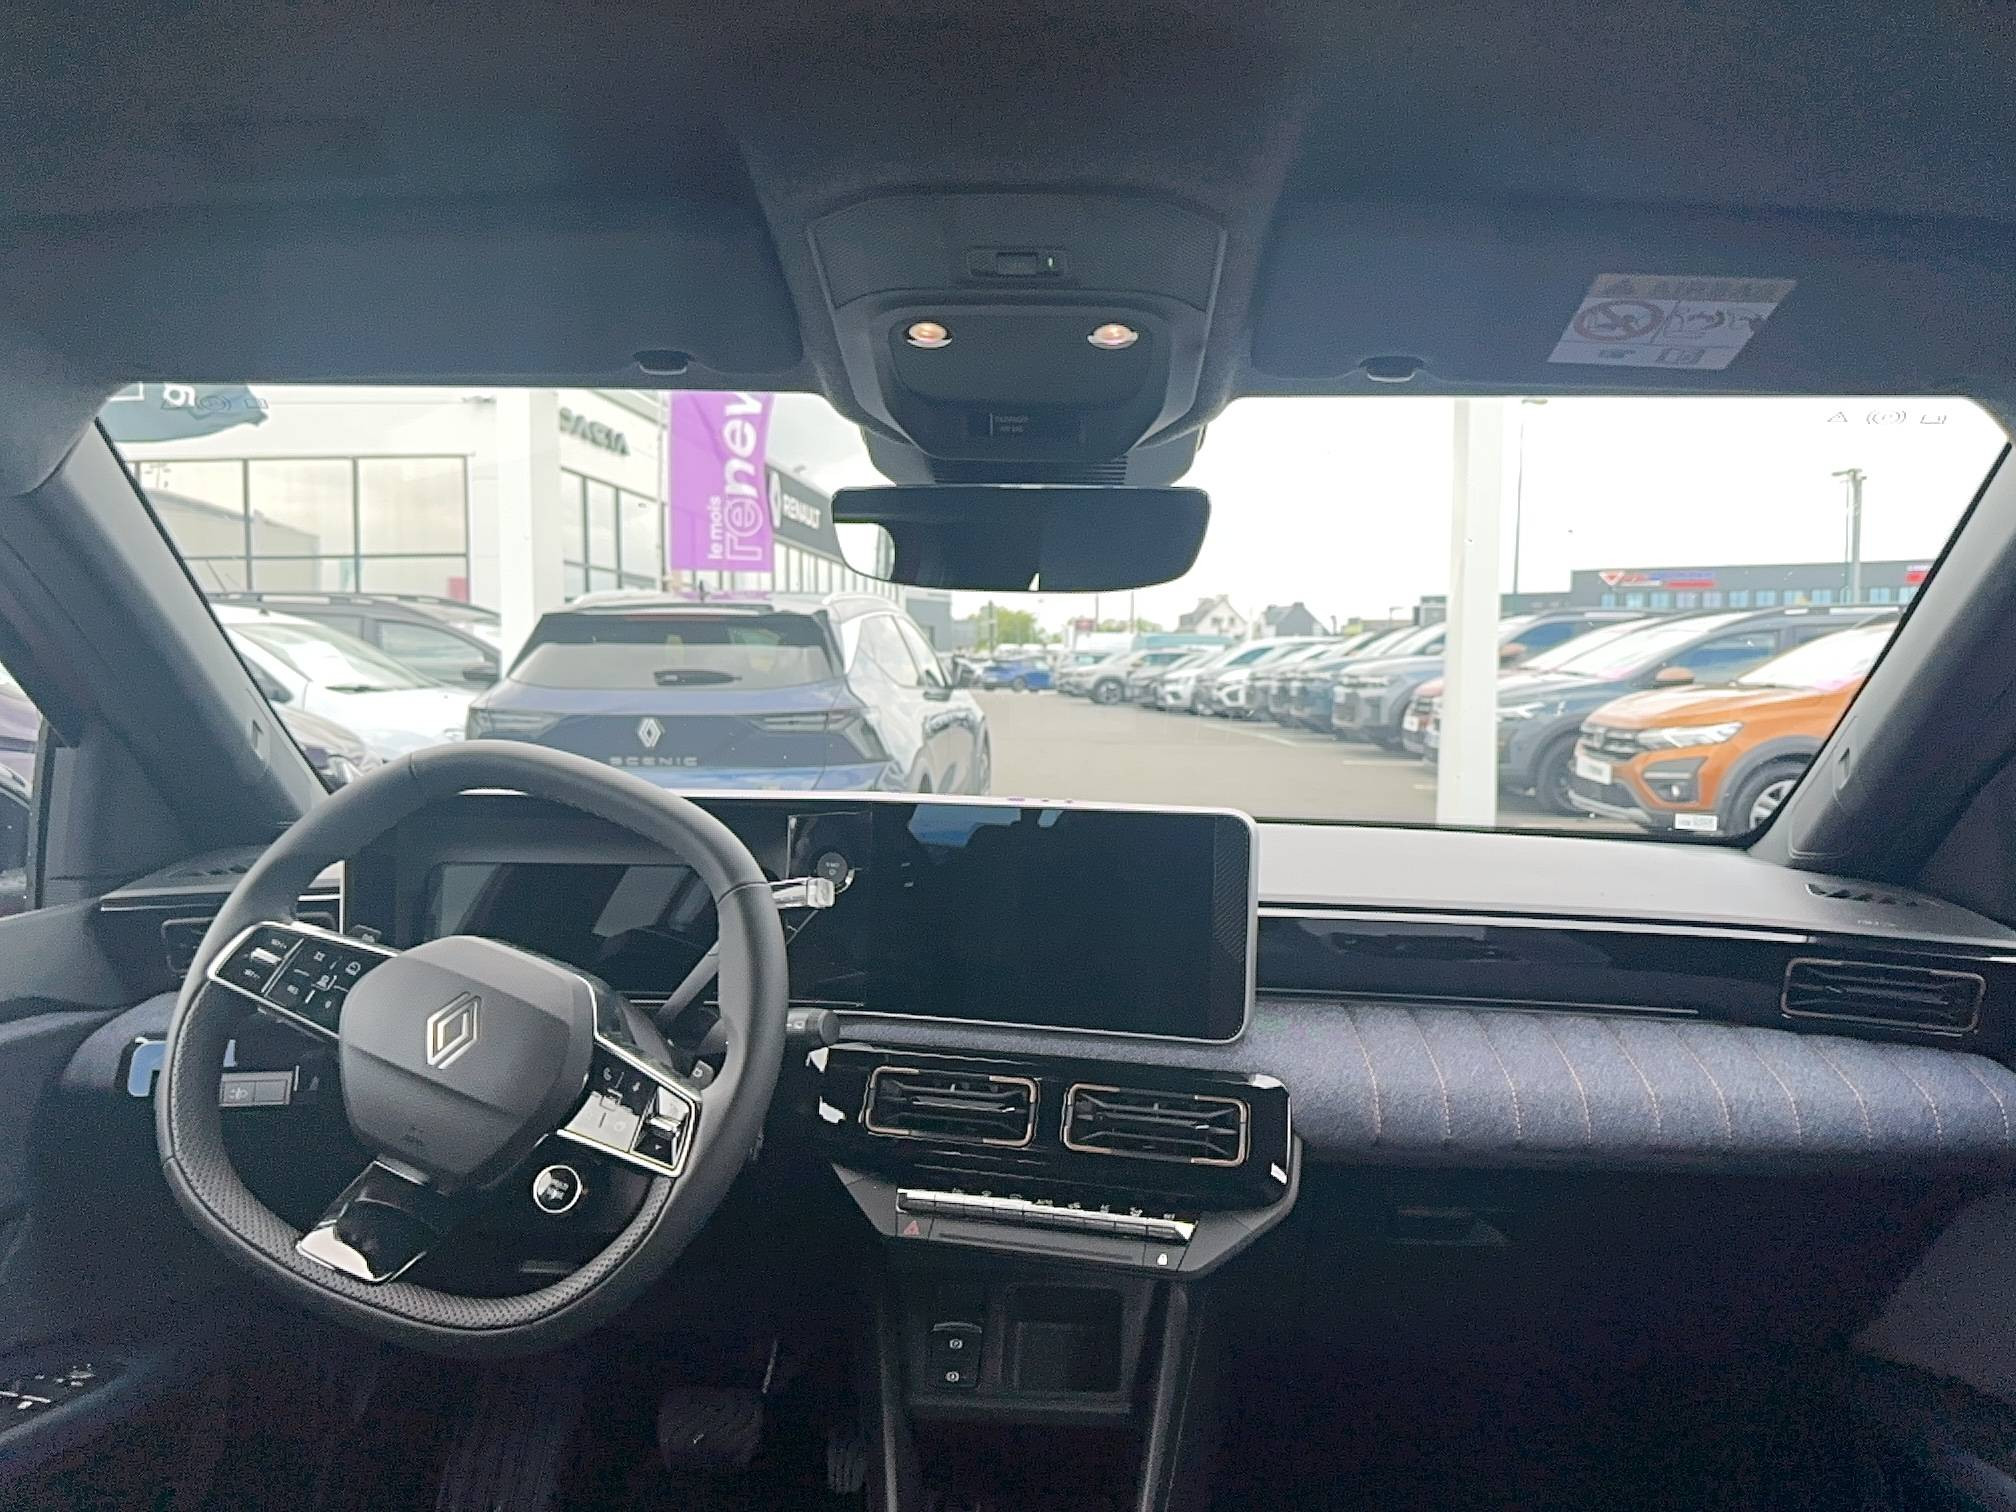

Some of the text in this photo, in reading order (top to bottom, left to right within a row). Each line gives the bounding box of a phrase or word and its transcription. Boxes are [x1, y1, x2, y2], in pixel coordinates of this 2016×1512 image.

[706, 495, 723, 560] le mois
[783, 493, 821, 529] RENAULT
[609, 756, 698, 767] SCENIC
